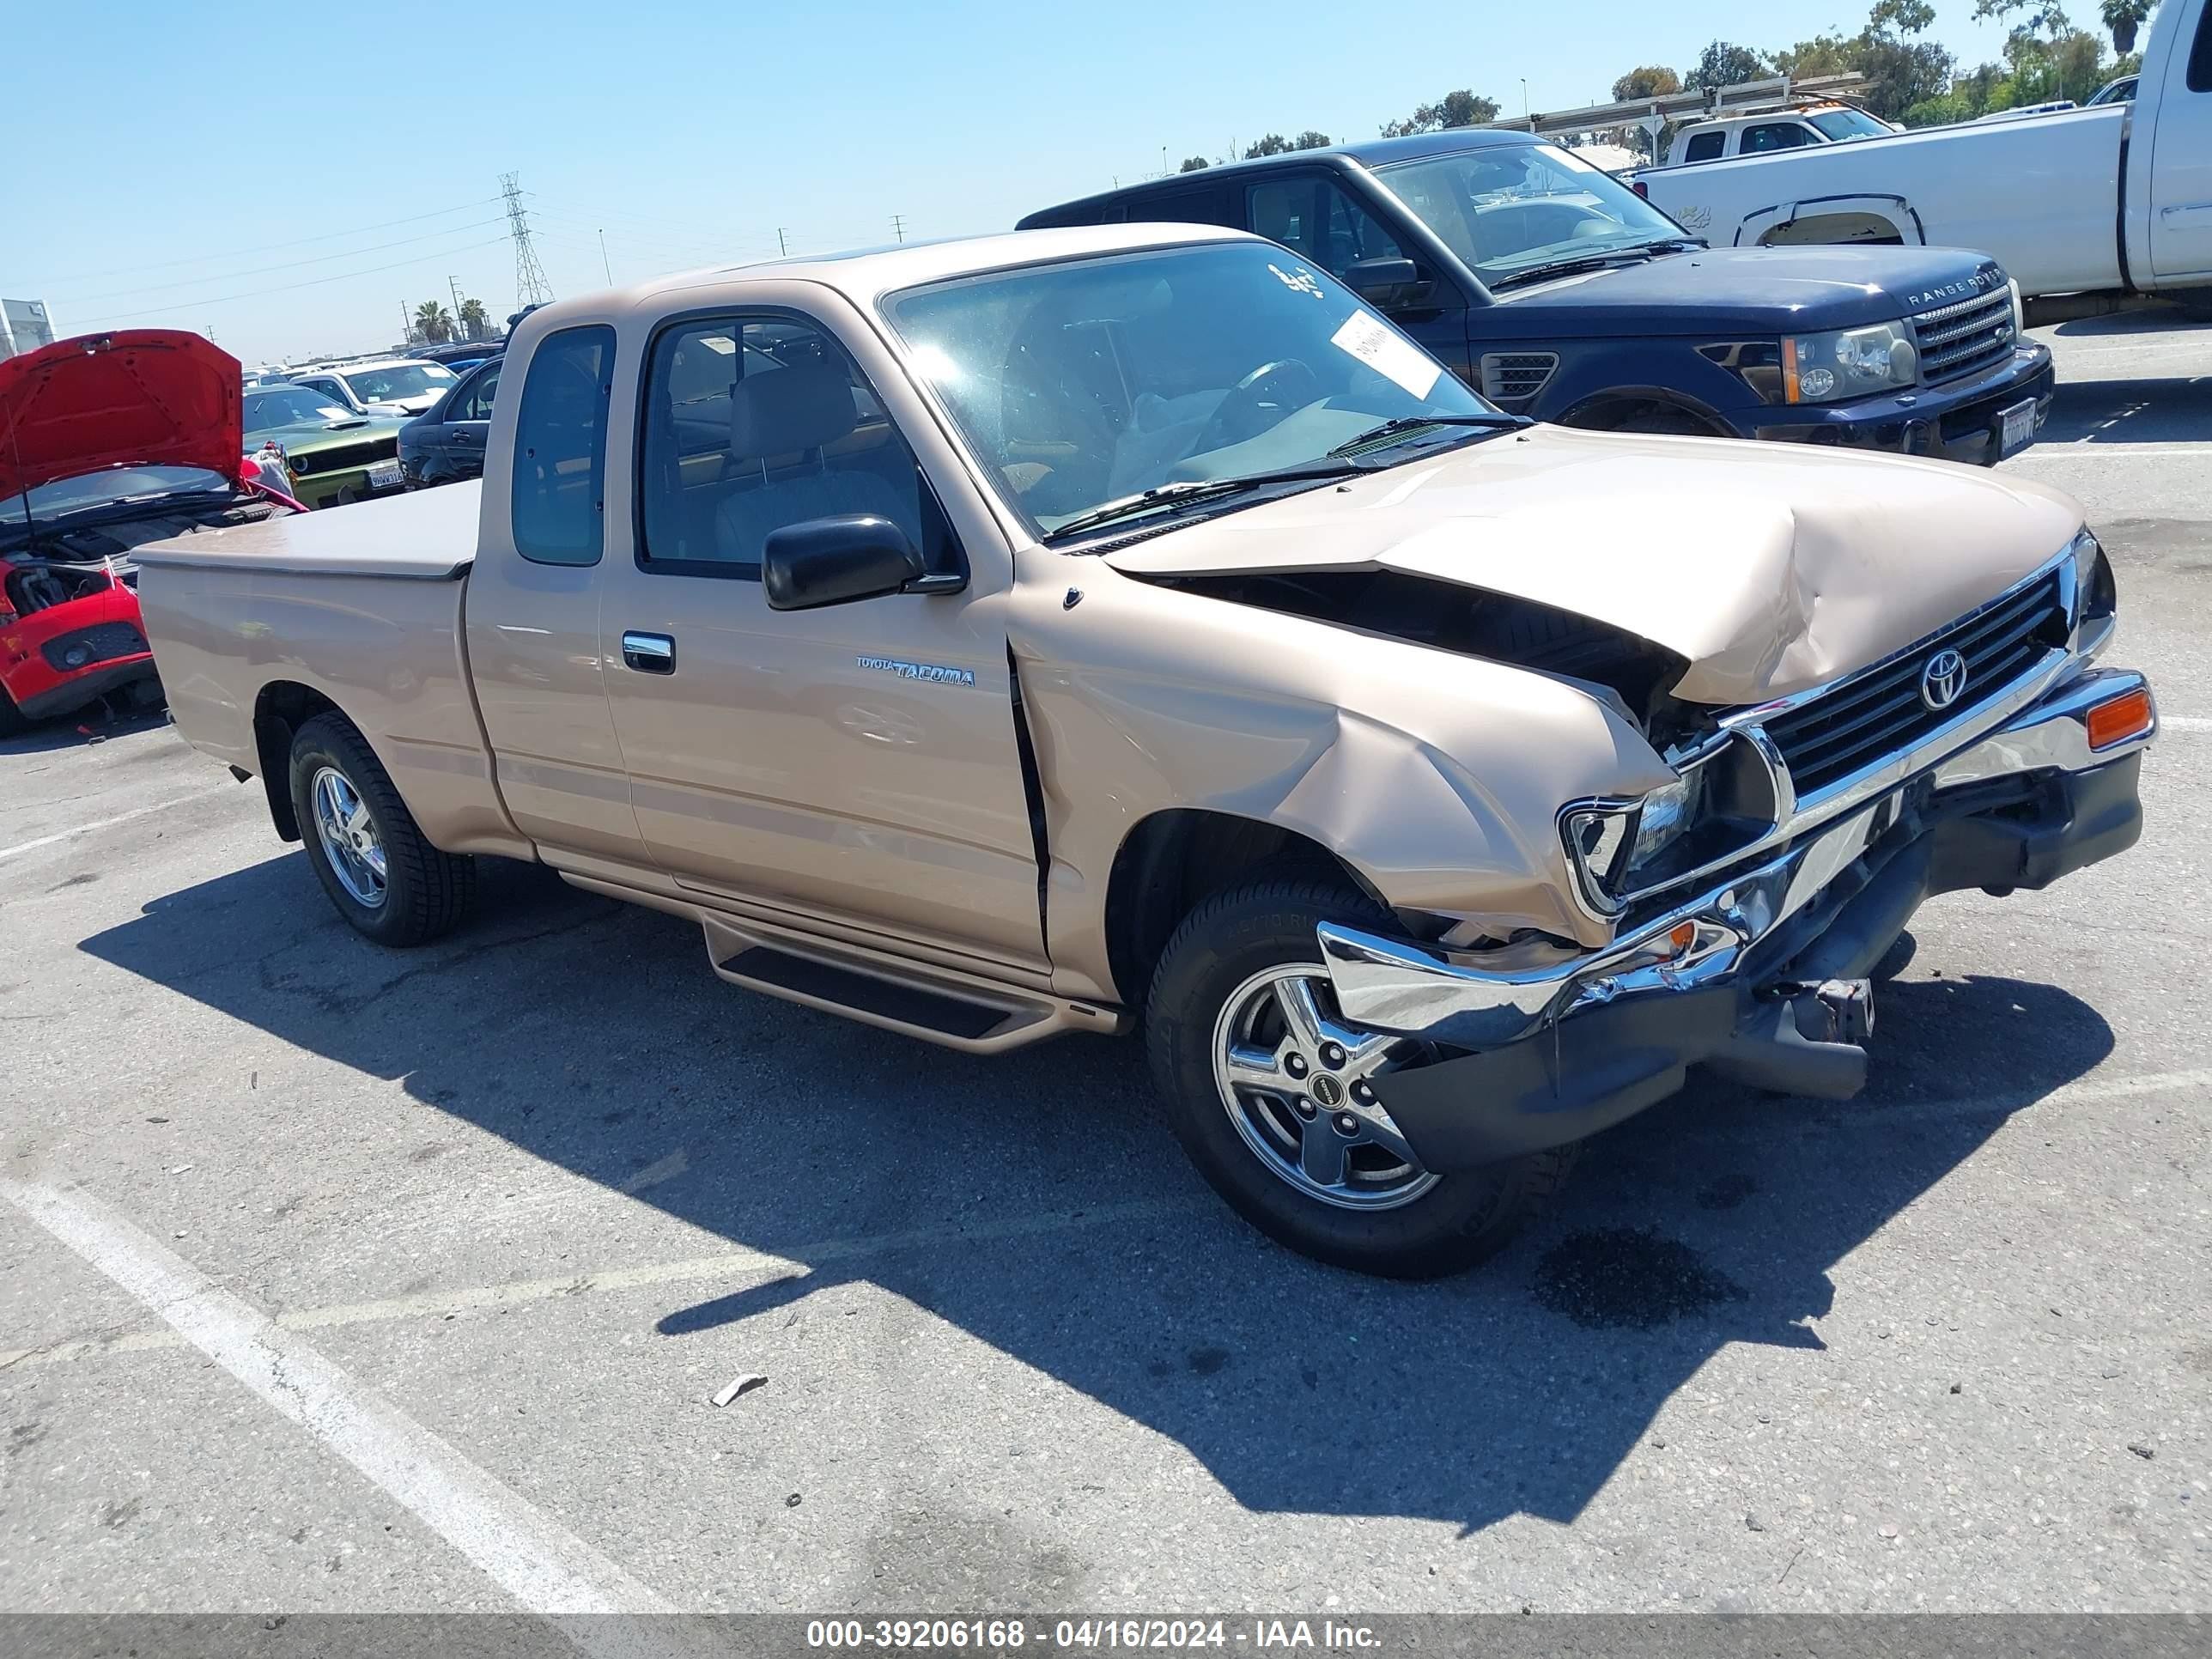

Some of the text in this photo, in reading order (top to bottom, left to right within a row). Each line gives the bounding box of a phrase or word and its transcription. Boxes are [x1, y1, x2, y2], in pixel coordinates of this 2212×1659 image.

[1908, 267, 2002, 307] RANGE ROVER
[856, 656, 975, 687] TOYOTA TACOMA
[1319, 1078, 1335, 1104] TOYOTA
